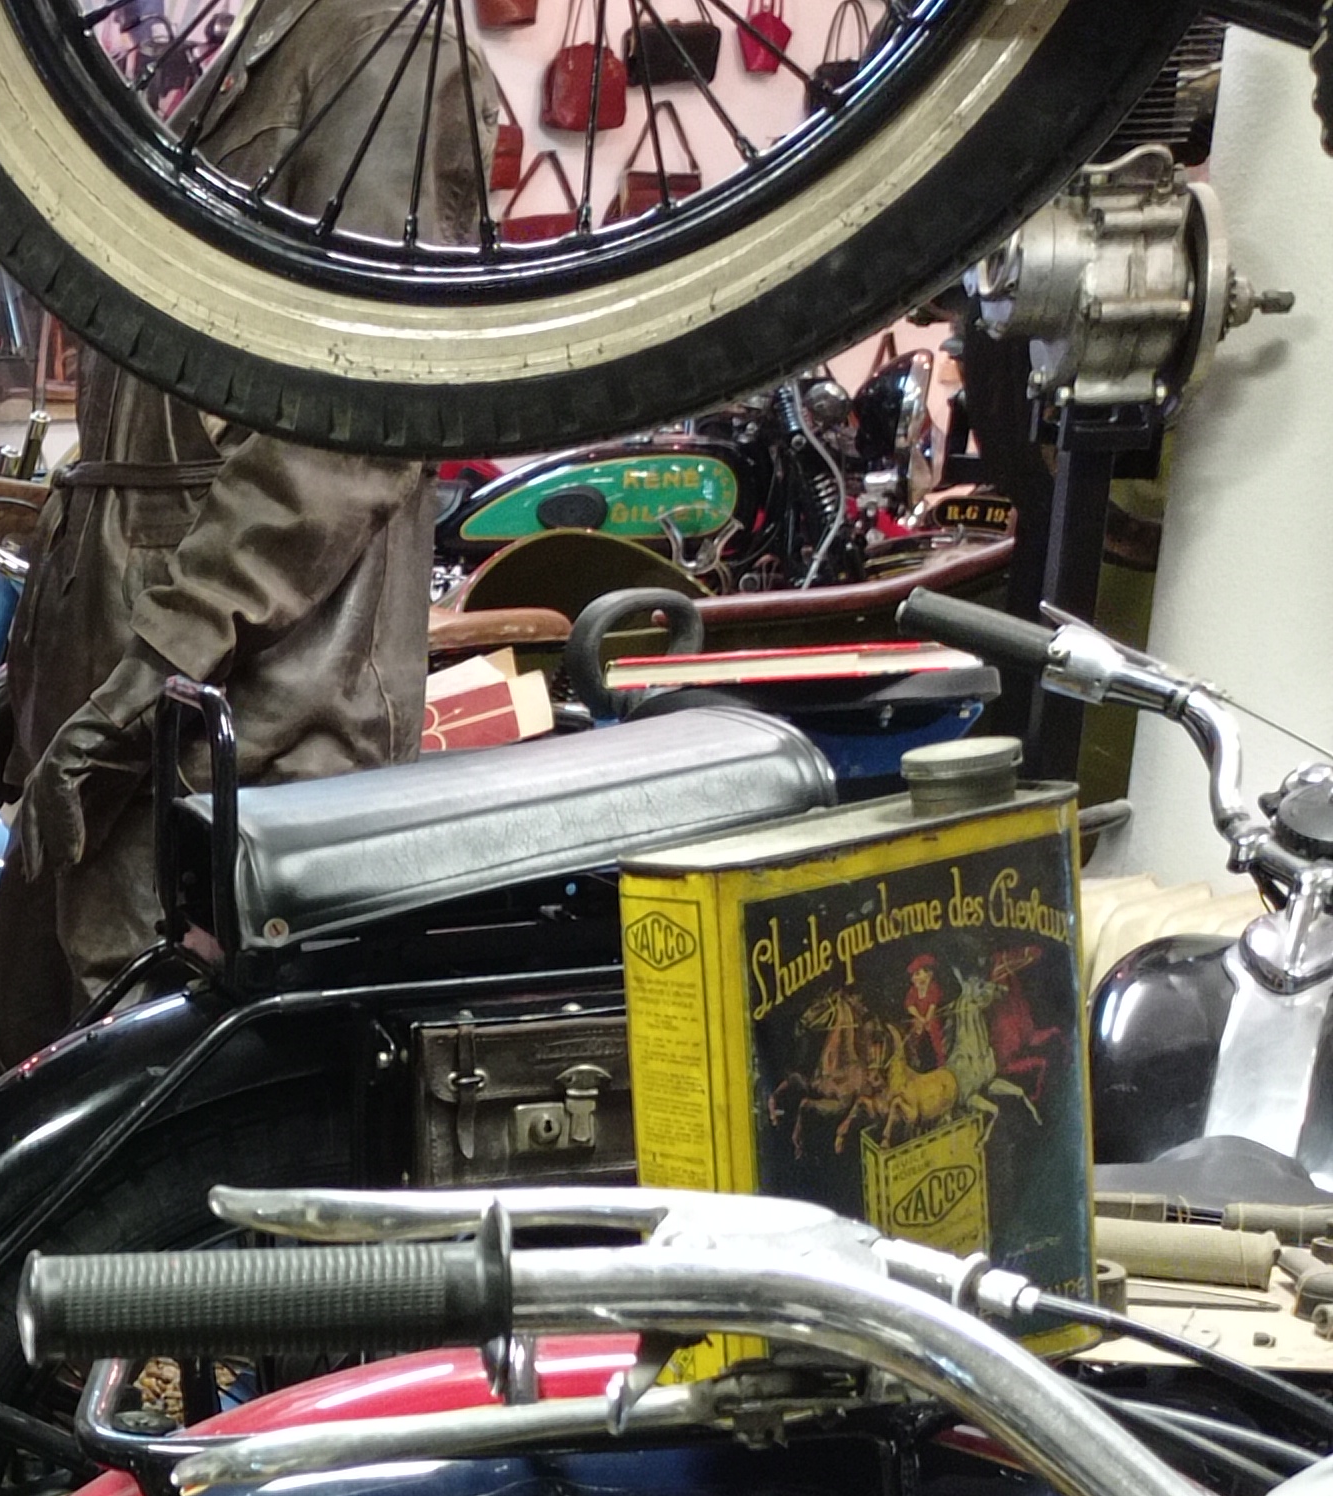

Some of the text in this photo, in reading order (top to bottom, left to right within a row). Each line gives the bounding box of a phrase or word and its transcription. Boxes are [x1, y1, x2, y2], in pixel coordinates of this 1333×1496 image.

[985, 507, 1011, 524] 19
[632, 917, 686, 965] YACCO
[752, 916, 833, 1021] L'huile
[875, 882, 943, 943] donne
[948, 866, 984, 926] des
[988, 867, 1071, 946] Chevaux
[901, 1169, 967, 1221] YACCO
